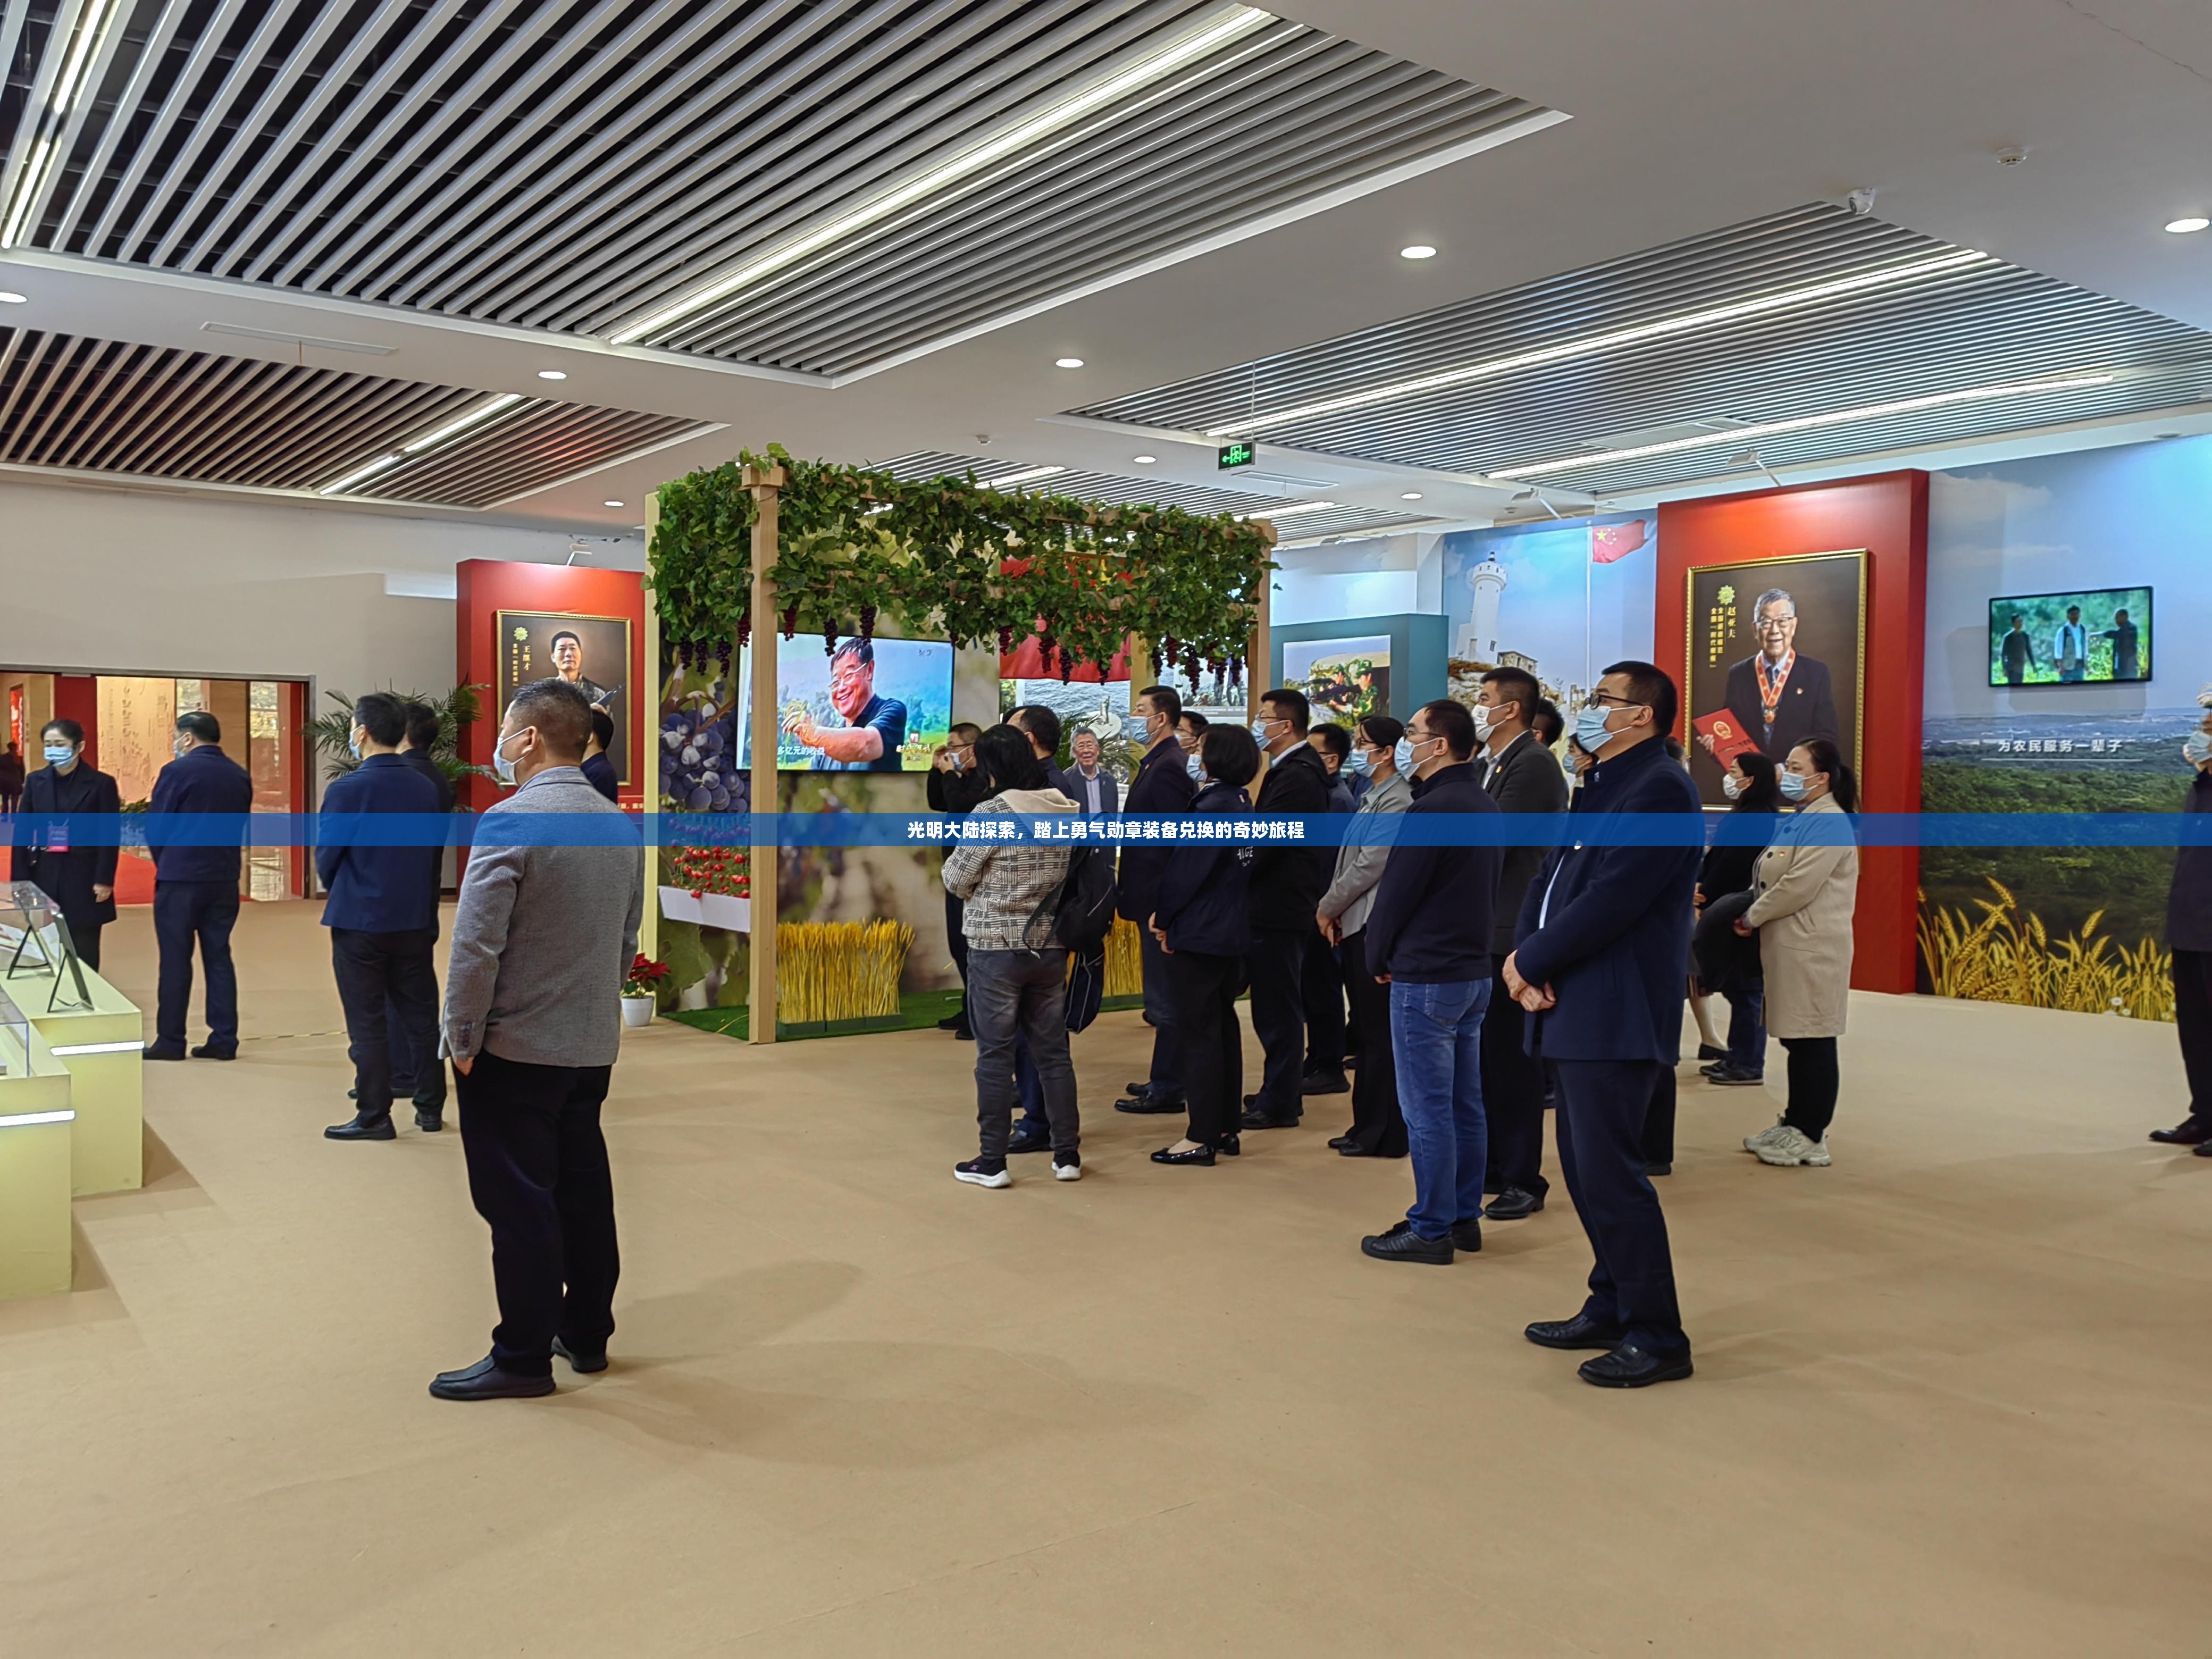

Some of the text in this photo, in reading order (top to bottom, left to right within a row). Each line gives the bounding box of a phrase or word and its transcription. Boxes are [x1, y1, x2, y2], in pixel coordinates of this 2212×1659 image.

[1998, 739, 2123, 752] 为农民服务一辈子
